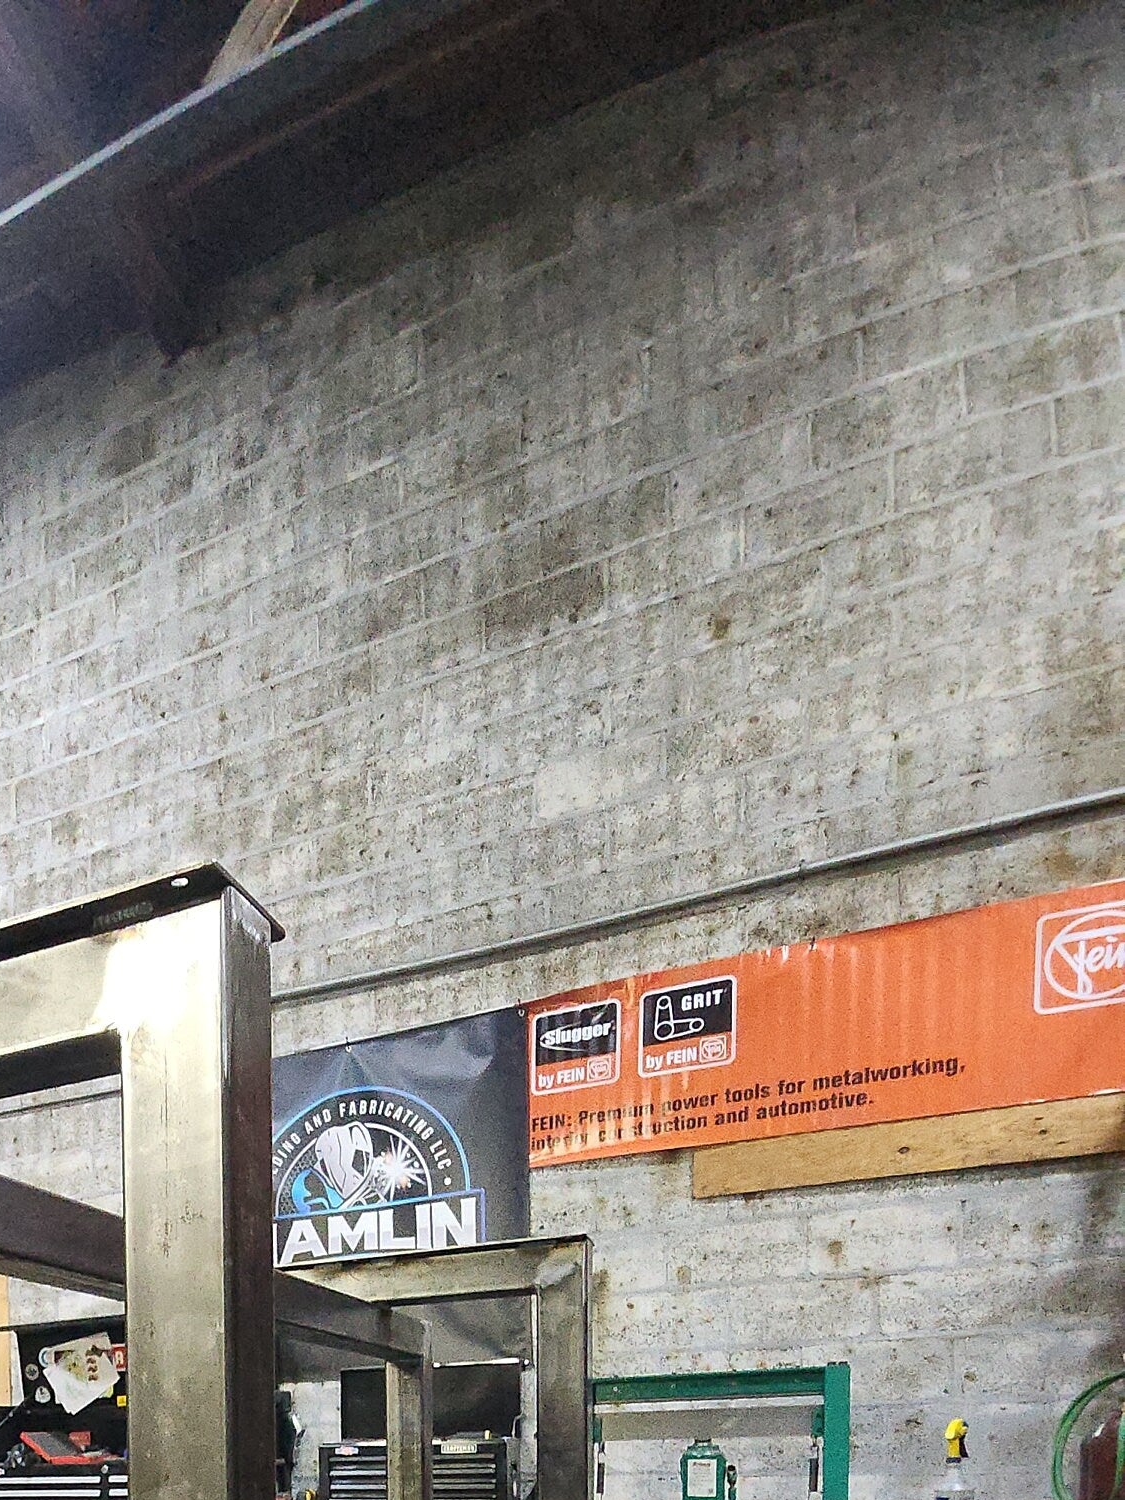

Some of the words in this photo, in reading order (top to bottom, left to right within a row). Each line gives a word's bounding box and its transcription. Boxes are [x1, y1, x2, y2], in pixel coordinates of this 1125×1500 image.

[681, 988, 724, 1011] GRIT
[544, 1022, 612, 1046] Slugger
[645, 1054, 664, 1071] by
[666, 1047, 698, 1065] FEIN
[531, 1112, 573, 1132] FEIN:
[578, 1101, 655, 1126] Premium
[661, 1092, 719, 1117] power
[724, 1083, 771, 1104] tools
[777, 1078, 806, 1096] for
[812, 1056, 966, 1091] metalworking,
[538, 1073, 555, 1089] by
[556, 1067, 585, 1084] FEIN
[304, 1108, 333, 1133] AND
[338, 1099, 435, 1143] FABRICATING
[429, 1139, 453, 1170] LLC
[598, 1114, 708, 1142] cnstuction
[714, 1106, 749, 1126] and
[756, 1091, 875, 1120] automotive.
[272, 1197, 477, 1268] AMLIN
